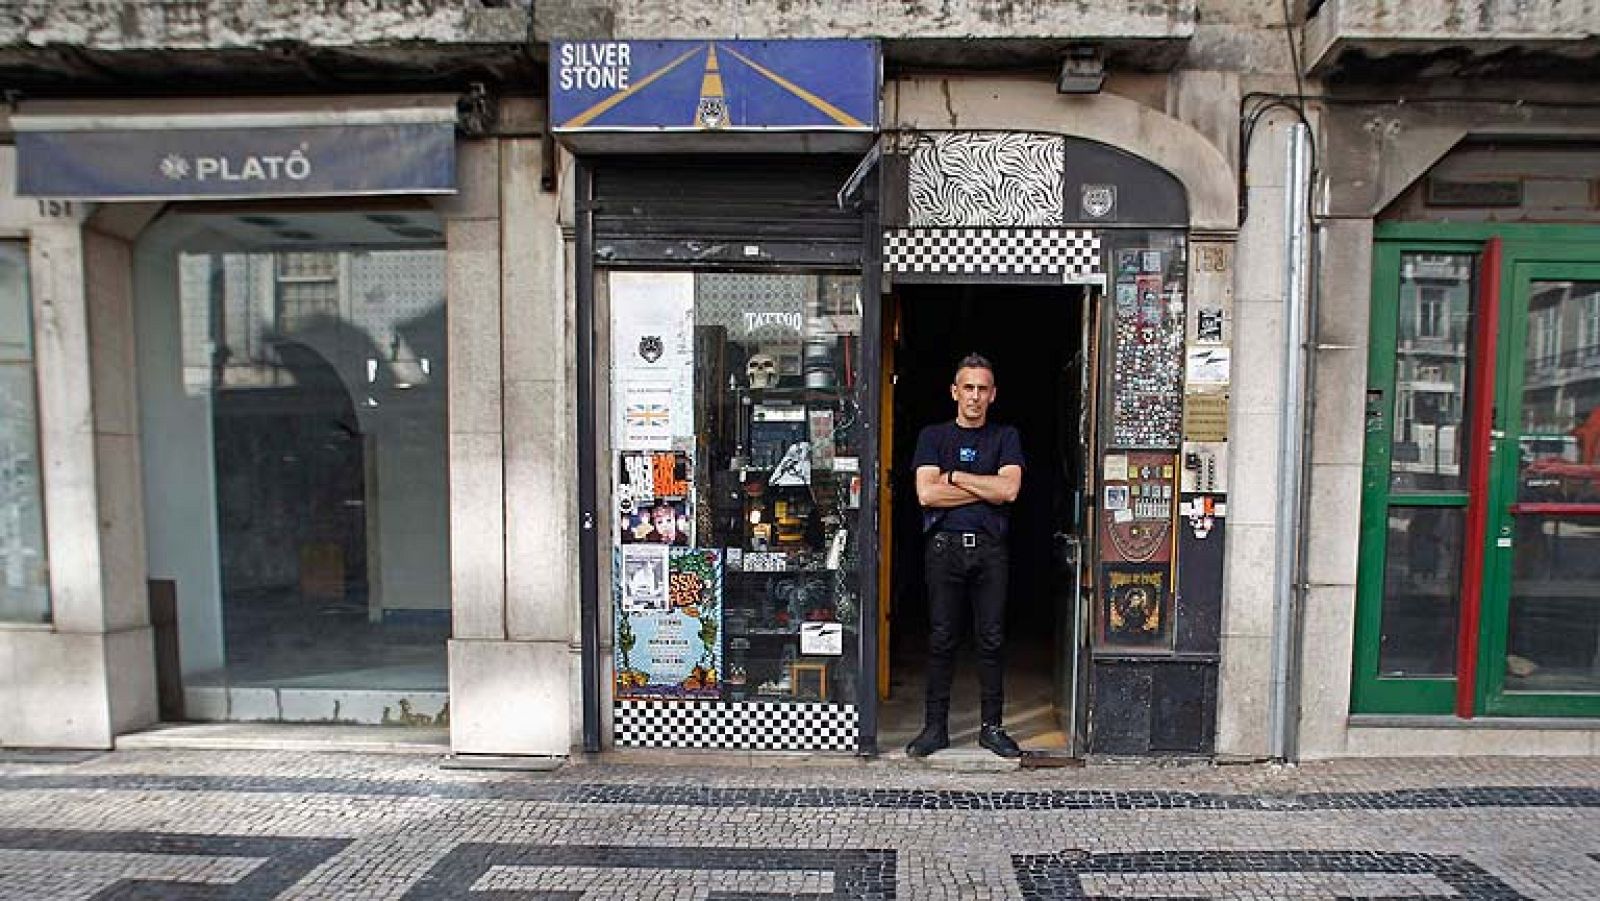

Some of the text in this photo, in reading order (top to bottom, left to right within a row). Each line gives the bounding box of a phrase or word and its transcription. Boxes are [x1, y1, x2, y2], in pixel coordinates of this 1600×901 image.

[561, 43, 631, 66] SILVER
[560, 67, 630, 90] STONE
[196, 149, 311, 181] PLATÔ
[745, 312, 802, 331] TATTOO
